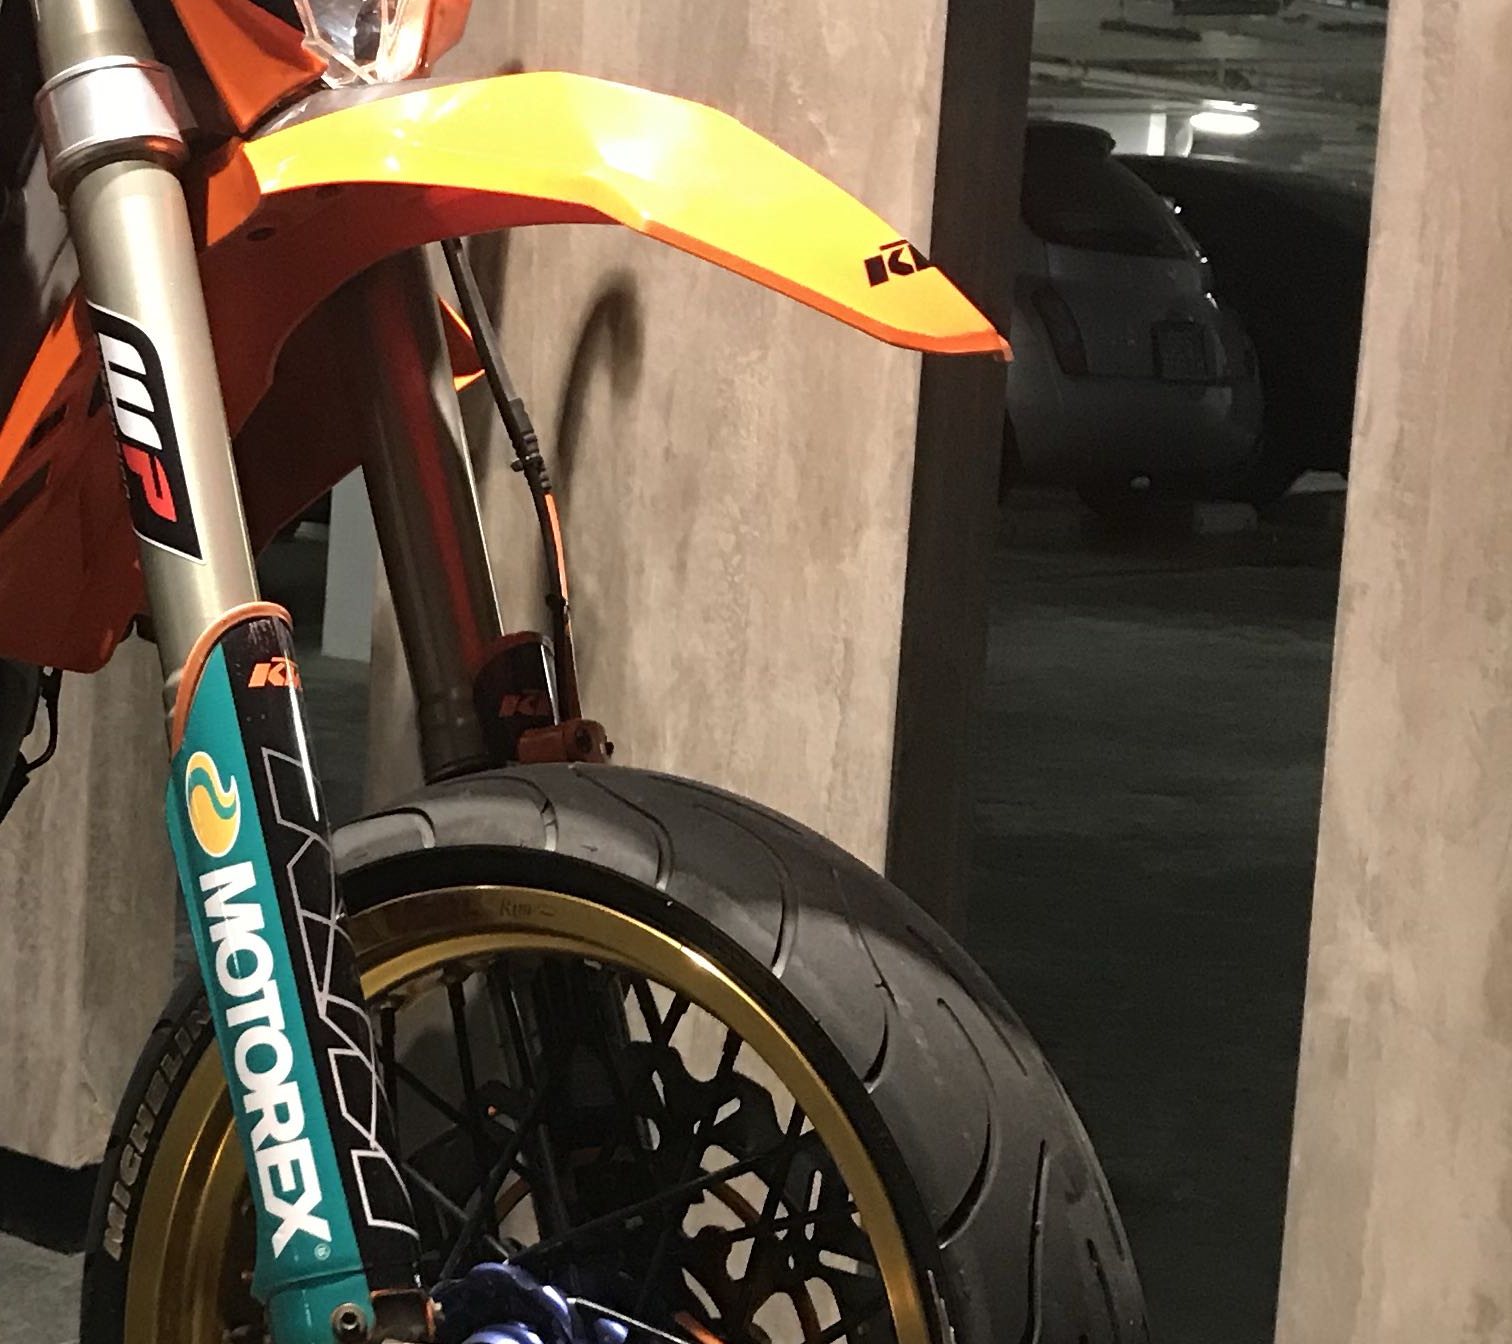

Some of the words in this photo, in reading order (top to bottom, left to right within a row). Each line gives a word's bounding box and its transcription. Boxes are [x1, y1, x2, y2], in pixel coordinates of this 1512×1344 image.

[98, 332, 178, 523] WP
[103, 995, 212, 1262] MICHELIN
[198, 860, 333, 1259] MOTOREX
